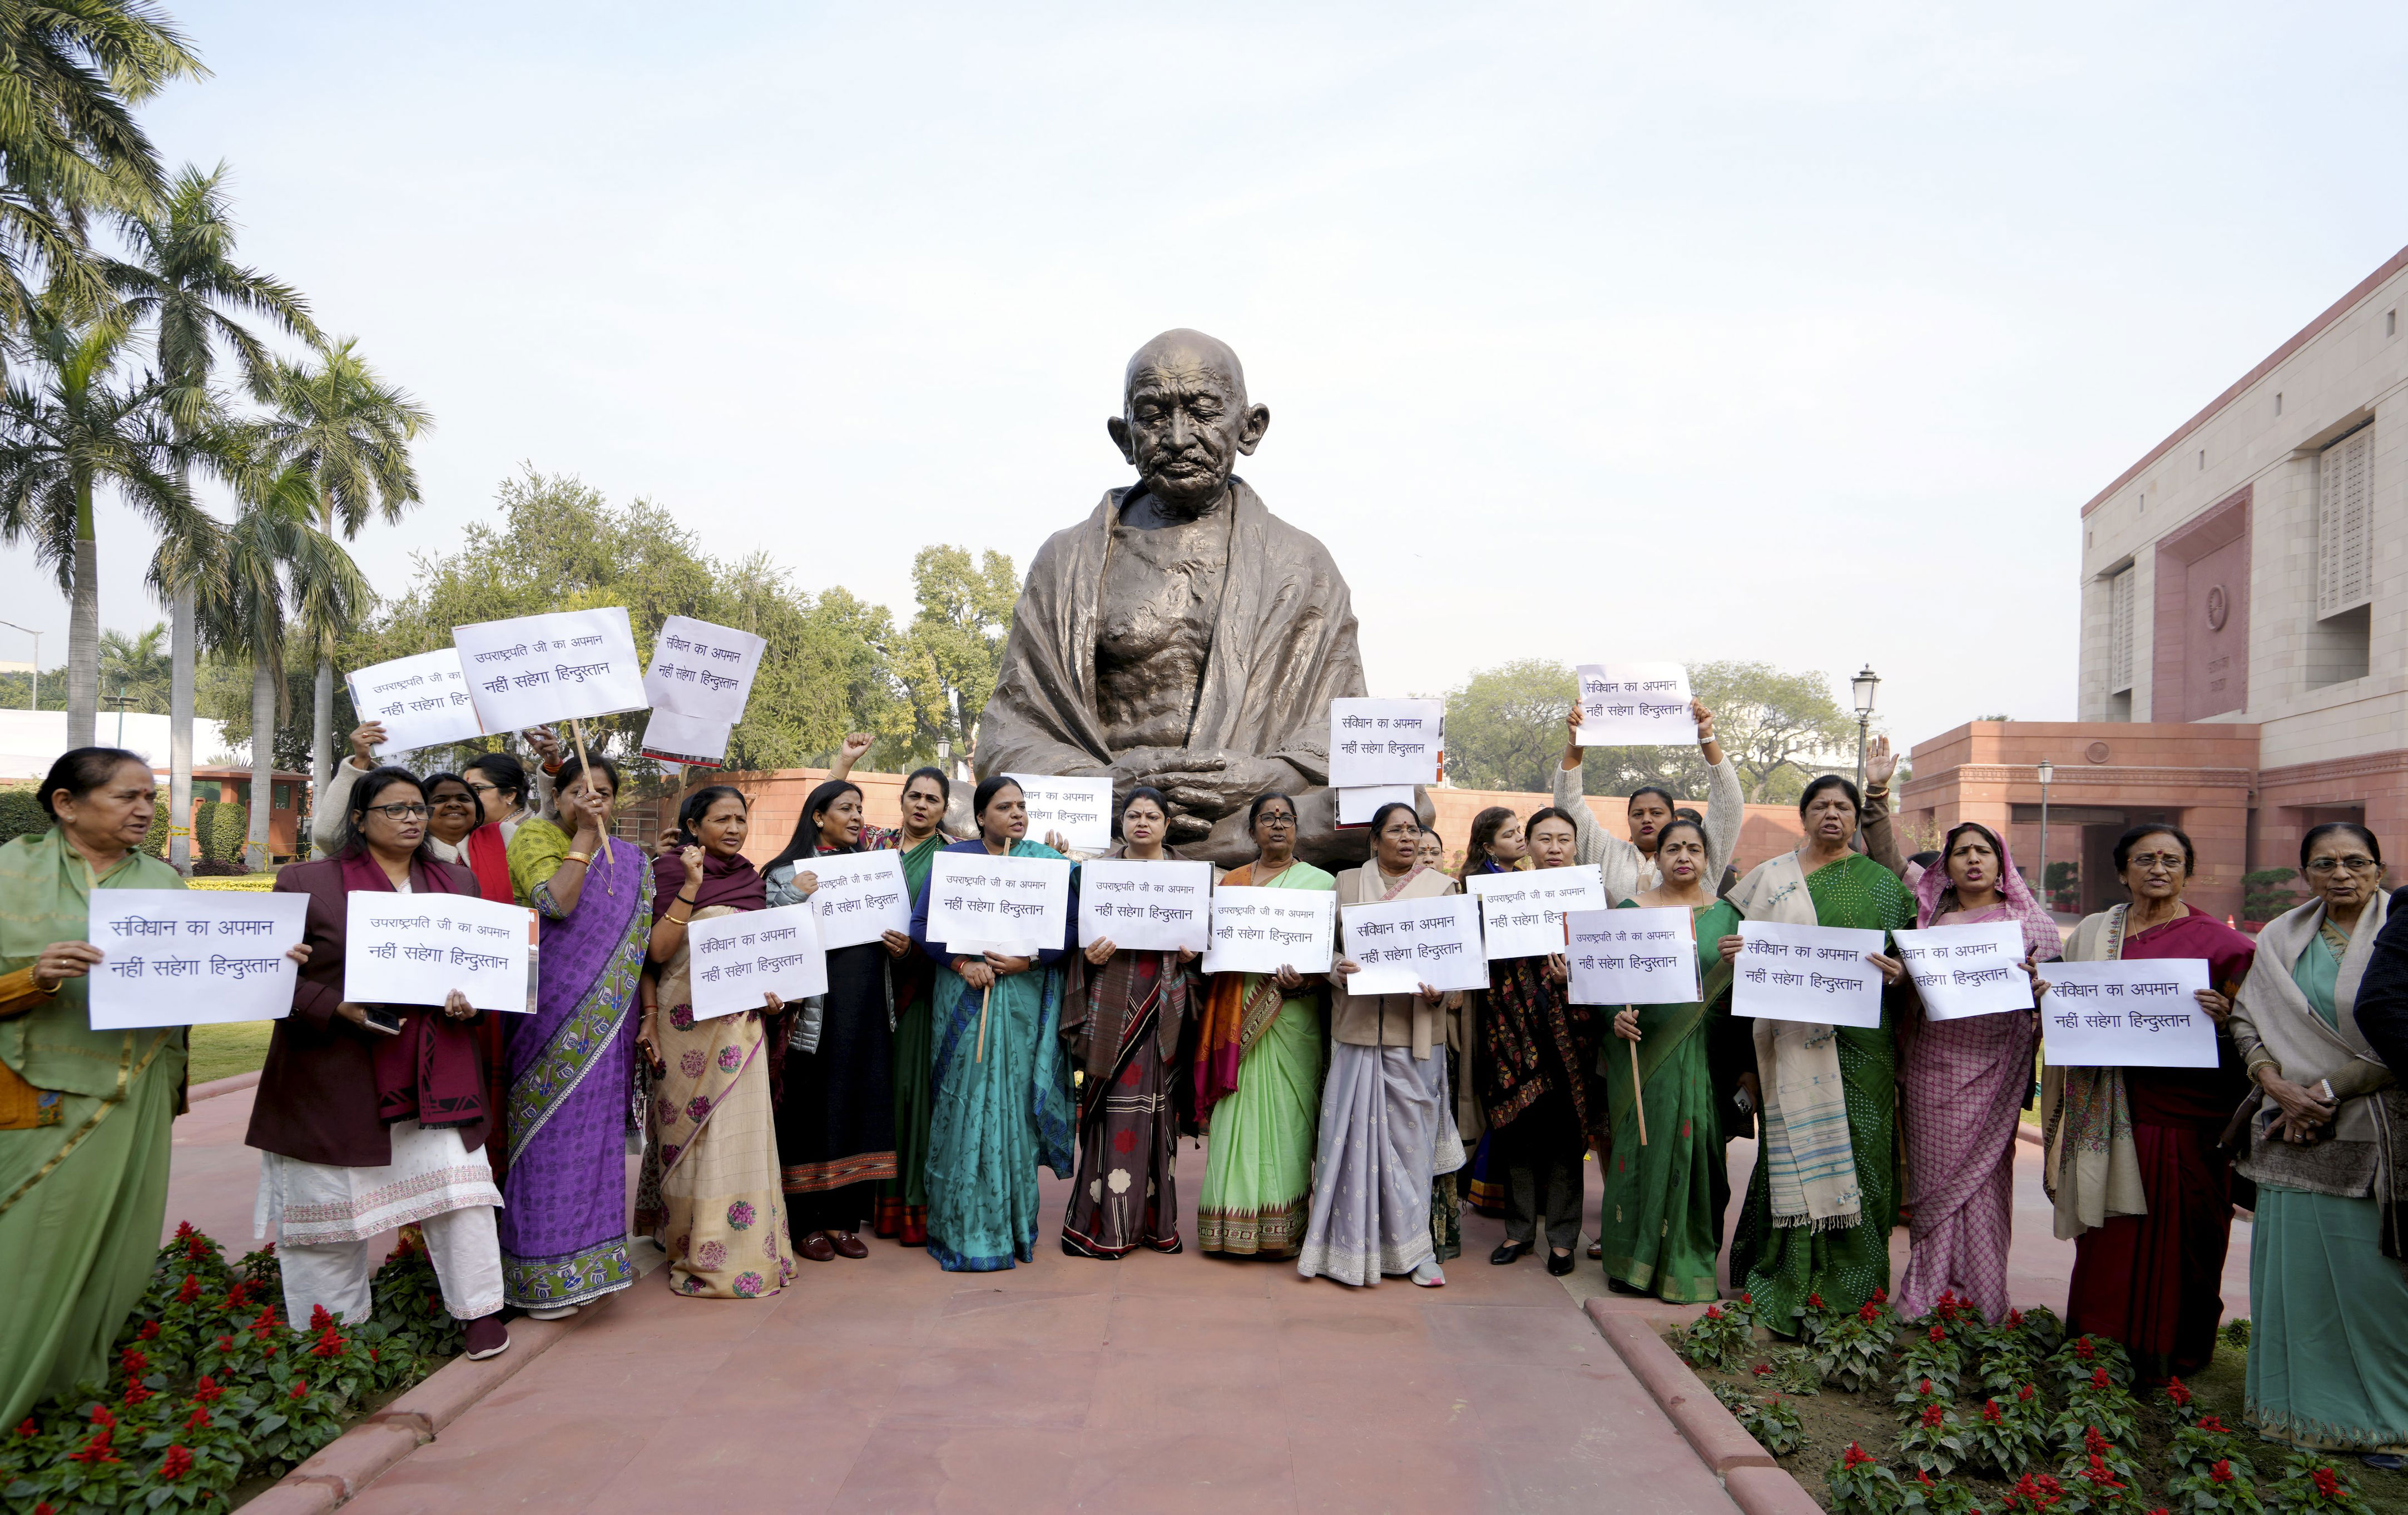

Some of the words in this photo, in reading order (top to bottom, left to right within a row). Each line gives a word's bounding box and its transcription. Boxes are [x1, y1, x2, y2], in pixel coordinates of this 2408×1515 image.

[474, 644, 528, 663] उपराष्ट्रपति
[532, 640, 547, 652] जी
[552, 640, 566, 649] का
[571, 635, 602, 647] अपमान
[667, 635, 691, 652] संविधान
[695, 643, 708, 656] का
[711, 648, 741, 663] अपमान
[373, 676, 423, 693] उपराष्ट्रपति
[428, 672, 442, 682] जी
[482, 676, 509, 693] नहीं
[512, 670, 549, 688] सहेगा
[554, 663, 610, 682] हिन्दुस्तान
[659, 663, 674, 678] नहीं
[676, 665, 697, 682] सहेगा
[701, 670, 739, 691] हिन्दुस्तान
[1586, 680, 1619, 693] संविधान
[1624, 683, 1638, 692] का
[1643, 681, 1677, 691] अपमान
[379, 702, 404, 716] नहीं
[408, 697, 444, 711] सहेगा
[1585, 704, 1603, 717] नहीं
[1607, 703, 1634, 716] सहेगा
[1639, 703, 1683, 718] हिन्दुस्तान
[1341, 715, 1373, 728] संविधान
[1377, 719, 1389, 728] का
[1393, 719, 1423, 729] अपमान
[1341, 741, 1357, 754] नहीं
[1360, 740, 1384, 754] सहेगा
[1388, 741, 1425, 757] हिन्दुस्तान
[1063, 793, 1094, 802] अपमान
[1028, 809, 1053, 819] सहेगा
[1057, 809, 1097, 823] हिन्दुस्तान
[818, 876, 848, 890] पराष्ट्रपति
[851, 873, 860, 883] जी
[875, 871, 893, 880] अपमान
[946, 876, 986, 886] उपराष्ट्रपति
[990, 877, 1001, 887] जी
[1020, 881, 1046, 890] अपमान
[1096, 881, 1135, 892] उपराष्ट्रपति
[1139, 882, 1150, 892] जी
[1168, 886, 1195, 894] अपमान
[836, 898, 861, 912] सहेगा
[865, 893, 899, 910] हिन्दुस्तान
[1487, 891, 1525, 903] उपराष्ट्रपति
[1529, 890, 1540, 898] जी
[1559, 888, 1585, 896] अपमान
[944, 897, 963, 910] नहीं
[967, 897, 995, 912] सहेगा
[1000, 900, 1044, 918] हिन्दुस्तान
[1094, 903, 1113, 916] नहीं
[1117, 903, 1144, 917] सहेगा
[1149, 905, 1193, 922] हिन्दुस्तान
[1218, 905, 1256, 916] उपराष्ट्रपति
[1260, 906, 1270, 915] जी
[109, 916, 178, 936] संविधान
[186, 921, 211, 935] का
[218, 921, 274, 935] अपमान
[370, 916, 431, 929] उपराष्ट्रपति
[437, 918, 452, 930] जी
[458, 923, 472, 932] का
[477, 926, 510, 938] अपमान
[1356, 922, 1394, 936] संविधान
[1399, 921, 1414, 932] का
[1420, 916, 1455, 929] अपमान
[1489, 915, 1508, 927] नहीं
[1511, 912, 1539, 925] सहेगा
[700, 937, 736, 953] संविधान
[741, 934, 755, 945] का
[761, 927, 796, 941] अपमान
[1216, 926, 1234, 938] नहीं
[1237, 926, 1265, 940] सहेगा
[1269, 927, 1313, 945] हिन्दुस्तान
[1576, 931, 1612, 943] उपराष्ट्रपति
[1616, 931, 1627, 941] जी
[1647, 931, 1675, 940] अपमान
[368, 942, 398, 958] नहीं
[403, 943, 444, 962] सहेगा
[450, 947, 509, 971] हिन्दुस्तान
[1359, 949, 1379, 963] नहीं
[1383, 946, 1412, 960] सहेगा
[1417, 943, 1463, 960] हिन्दुस्तान
[1747, 940, 1788, 956] संविधान
[1794, 946, 1812, 958] का
[1817, 948, 1859, 962] अपमान
[1931, 948, 1949, 958] का
[1955, 943, 1998, 956] अपमान
[110, 956, 145, 977] नहीं
[152, 955, 201, 976] सहेगा
[209, 954, 281, 979] हिन्दुस्तान
[701, 966, 720, 982] नहीं
[724, 962, 752, 977] सहेगा
[757, 954, 803, 972] हिन्दुस्तान
[1578, 955, 1594, 970] नहीं
[1597, 955, 1624, 969] सहेगा
[1629, 954, 1677, 972] हिन्दुस्तान
[1745, 968, 1767, 983] नहीं
[1771, 970, 1804, 986] सहेगा
[1810, 972, 1864, 992] हिन्दुस्तान
[1915, 971, 1946, 986] सहेगा
[1952, 968, 2008, 987] हिन्दुस्तान
[2051, 981, 2098, 997] संविधान
[2104, 985, 2124, 996] का
[2131, 983, 2179, 995] अपमान
[2054, 1012, 2079, 1028] नहीं
[2084, 1011, 2122, 1028] सहेगा
[2128, 1011, 2191, 1032] हिन्दुस्तान
